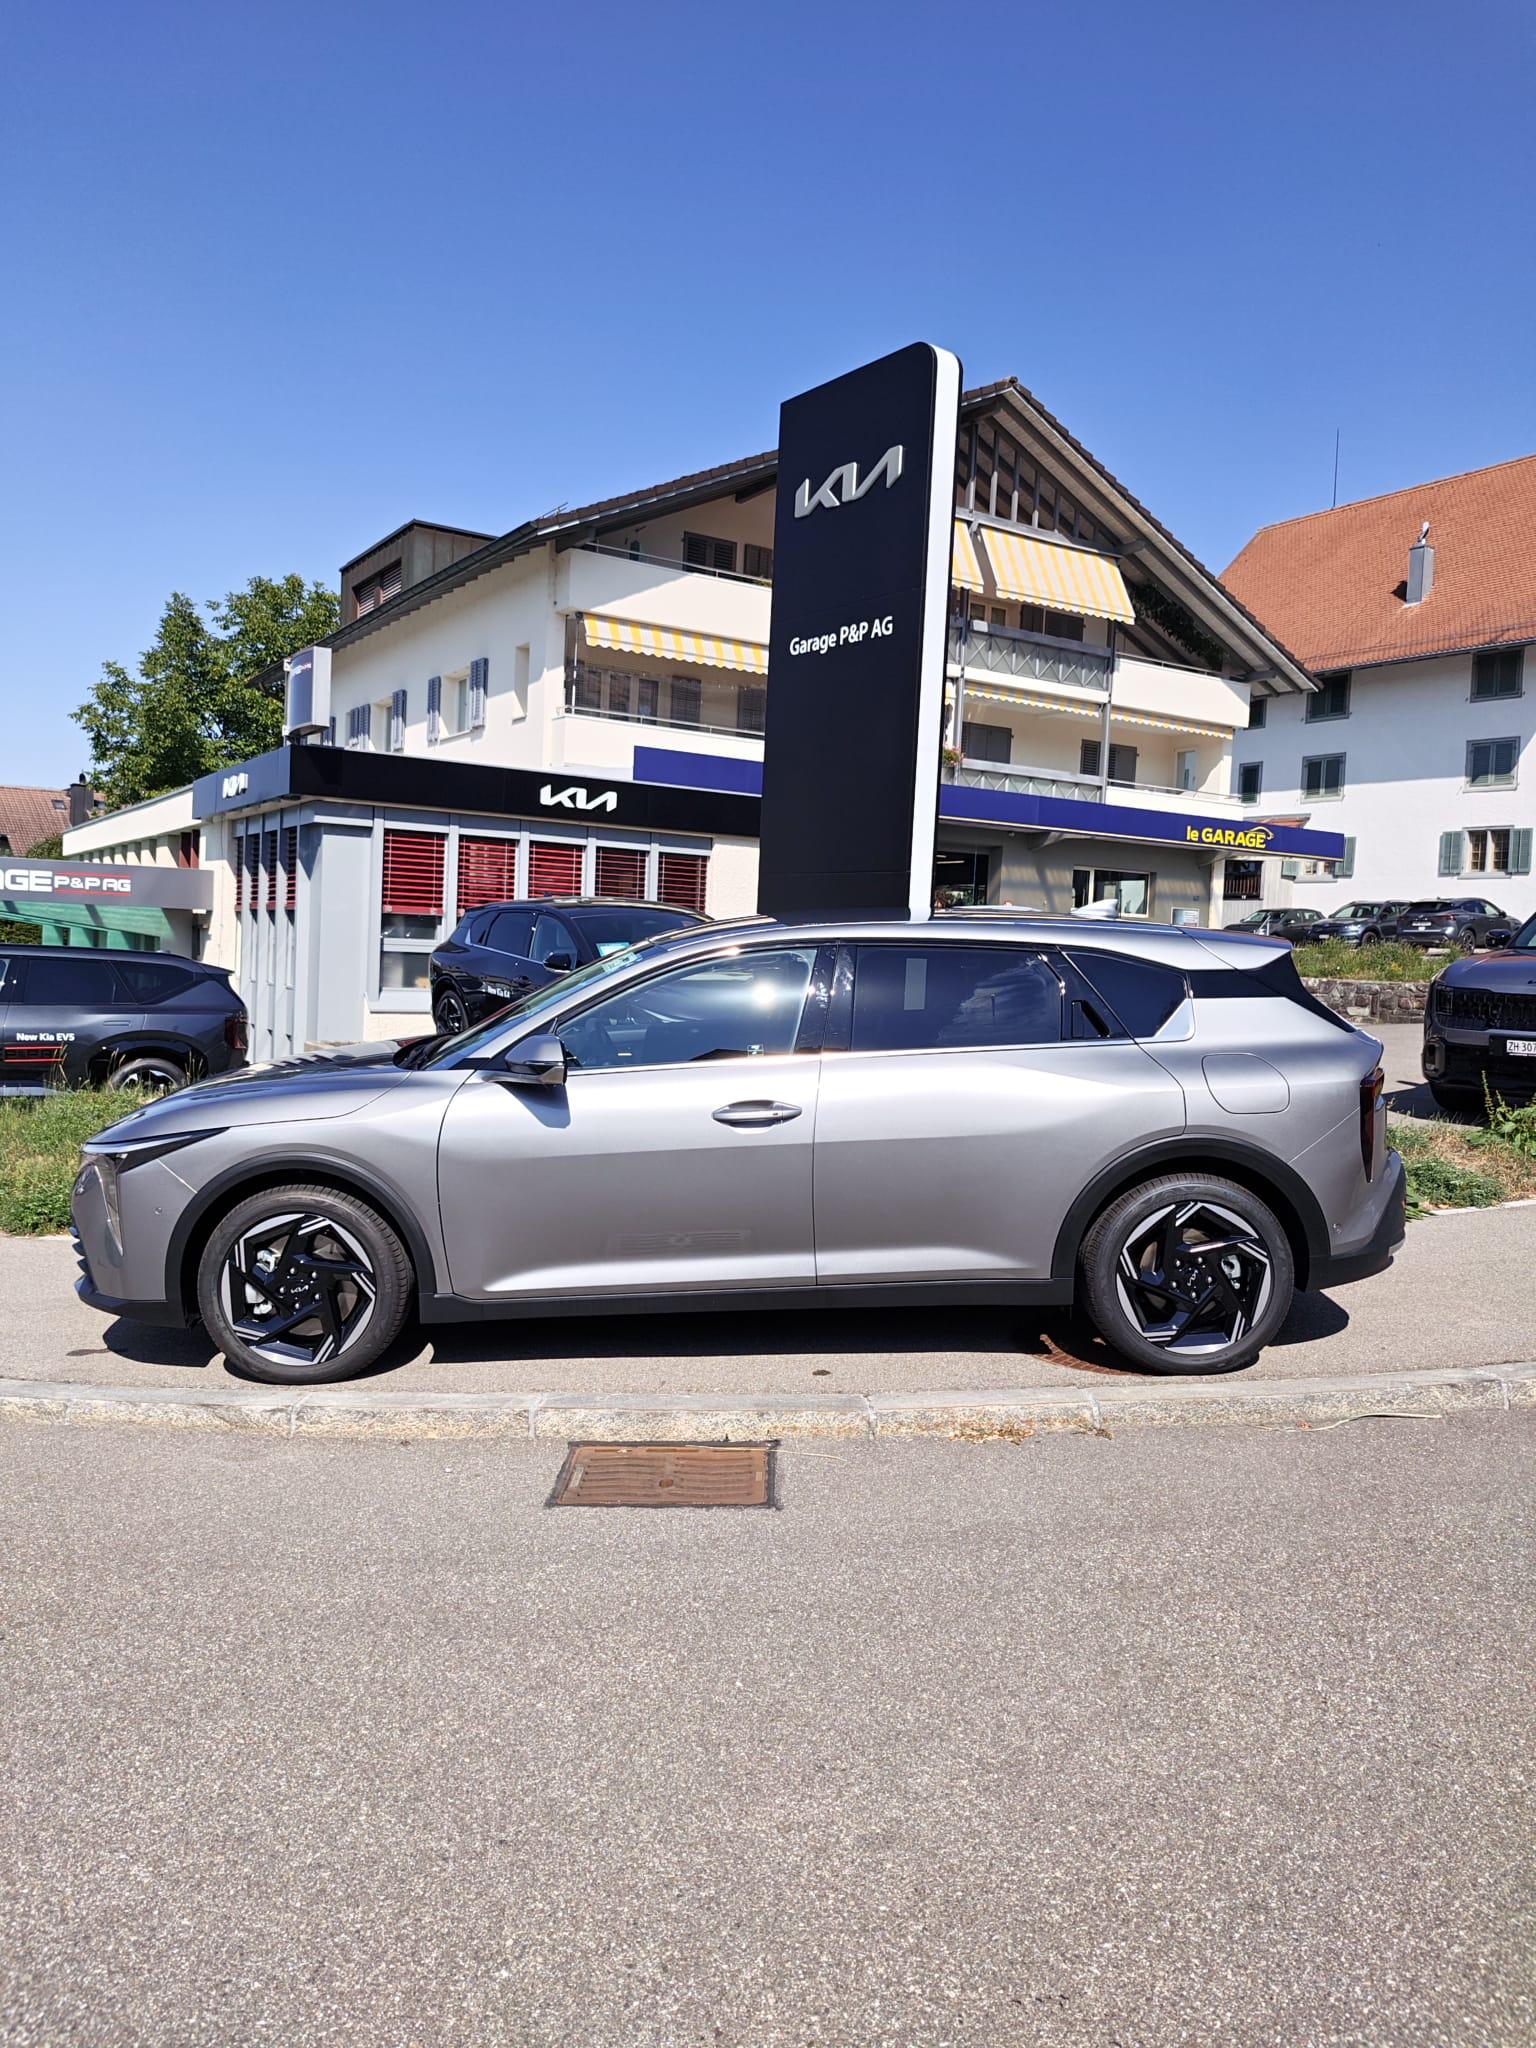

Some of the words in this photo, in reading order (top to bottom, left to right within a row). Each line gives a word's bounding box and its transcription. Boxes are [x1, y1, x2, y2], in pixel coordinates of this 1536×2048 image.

[794, 444, 903, 518] KIA
[789, 632, 837, 656] Garage
[839, 621, 869, 645] P&P
[870, 615, 894, 639] AG
[540, 784, 617, 812] KIA
[1186, 825, 1199, 841] le
[1201, 827, 1267, 849] GARAGE
[0, 868, 53, 893] GE
[54, 875, 101, 890] P&P
[102, 878, 132, 892] AG
[16, 1032, 38, 1041] New
[39, 1032, 55, 1041] Kia
[56, 1033, 76, 1041] EV5
[1508, 1041, 1519, 1051] ZH
